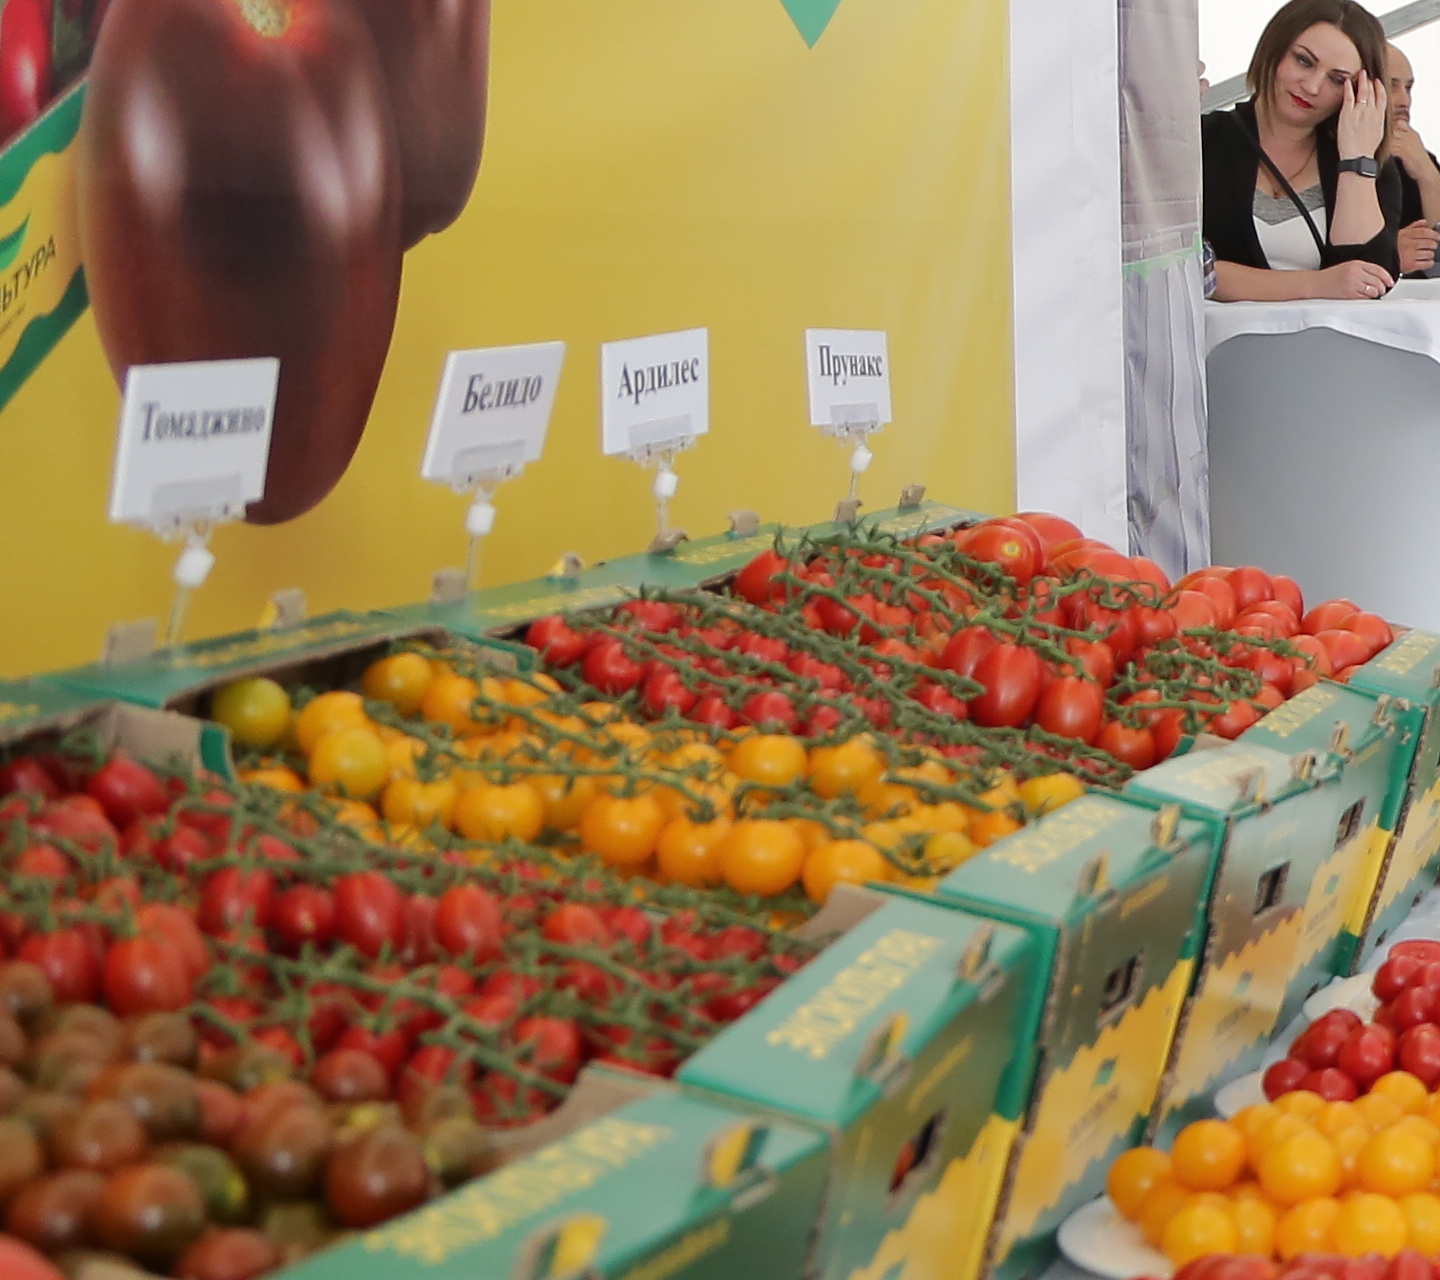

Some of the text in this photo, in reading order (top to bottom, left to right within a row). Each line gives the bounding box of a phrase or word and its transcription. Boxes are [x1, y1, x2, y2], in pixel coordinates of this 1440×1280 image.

[616, 356, 700, 405] Ардилес
[817, 344, 884, 387] Прунакс
[460, 371, 544, 415] Белидо
[141, 399, 267, 443] Томаджино
